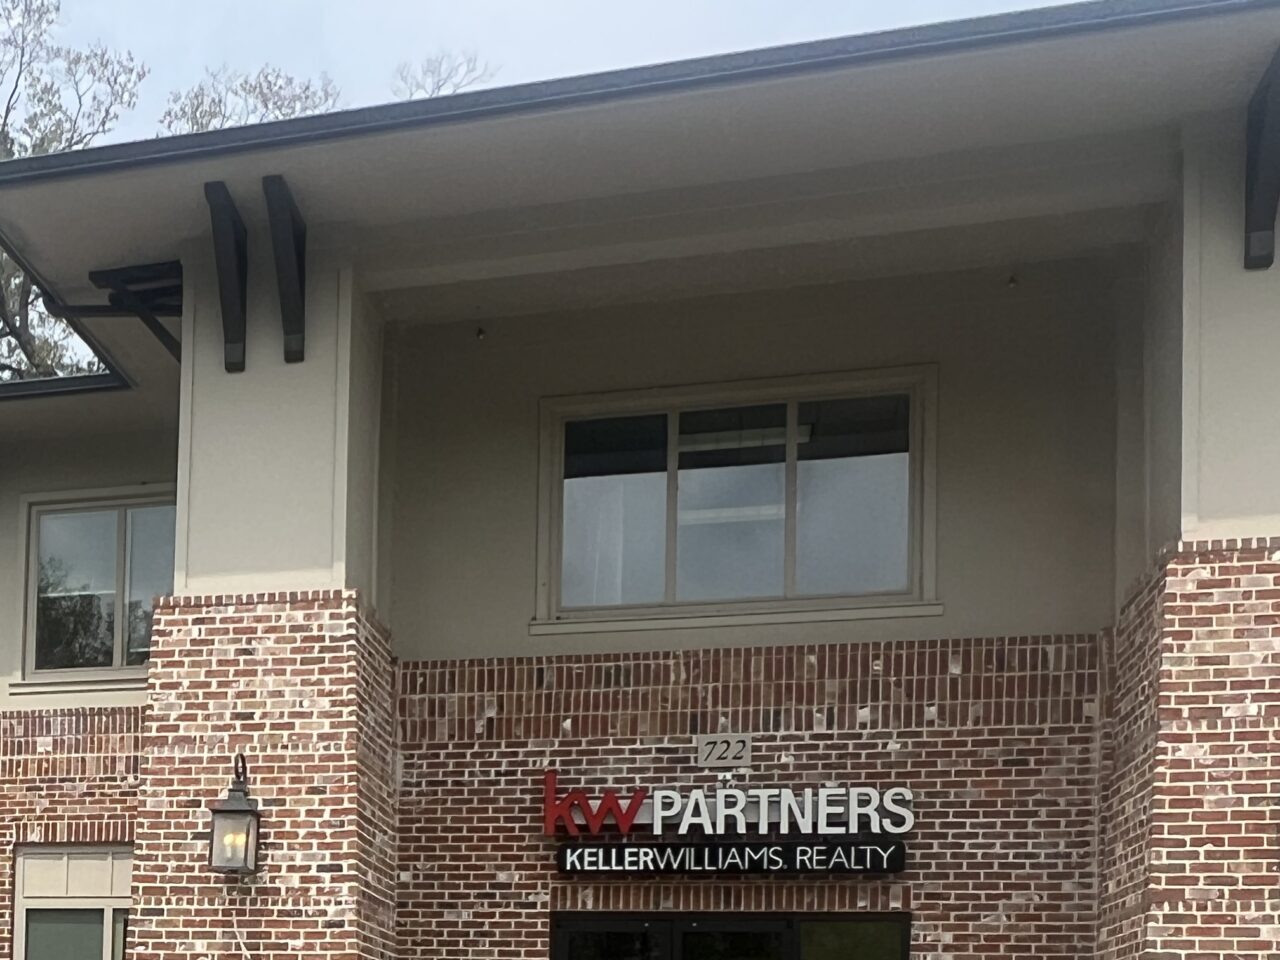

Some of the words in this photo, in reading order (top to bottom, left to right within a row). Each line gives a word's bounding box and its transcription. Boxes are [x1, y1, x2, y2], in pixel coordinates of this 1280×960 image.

[703, 739, 746, 761] 722
[544, 769, 646, 836] kw
[652, 787, 915, 835] PARTNERS
[796, 845, 895, 869] REALTY
